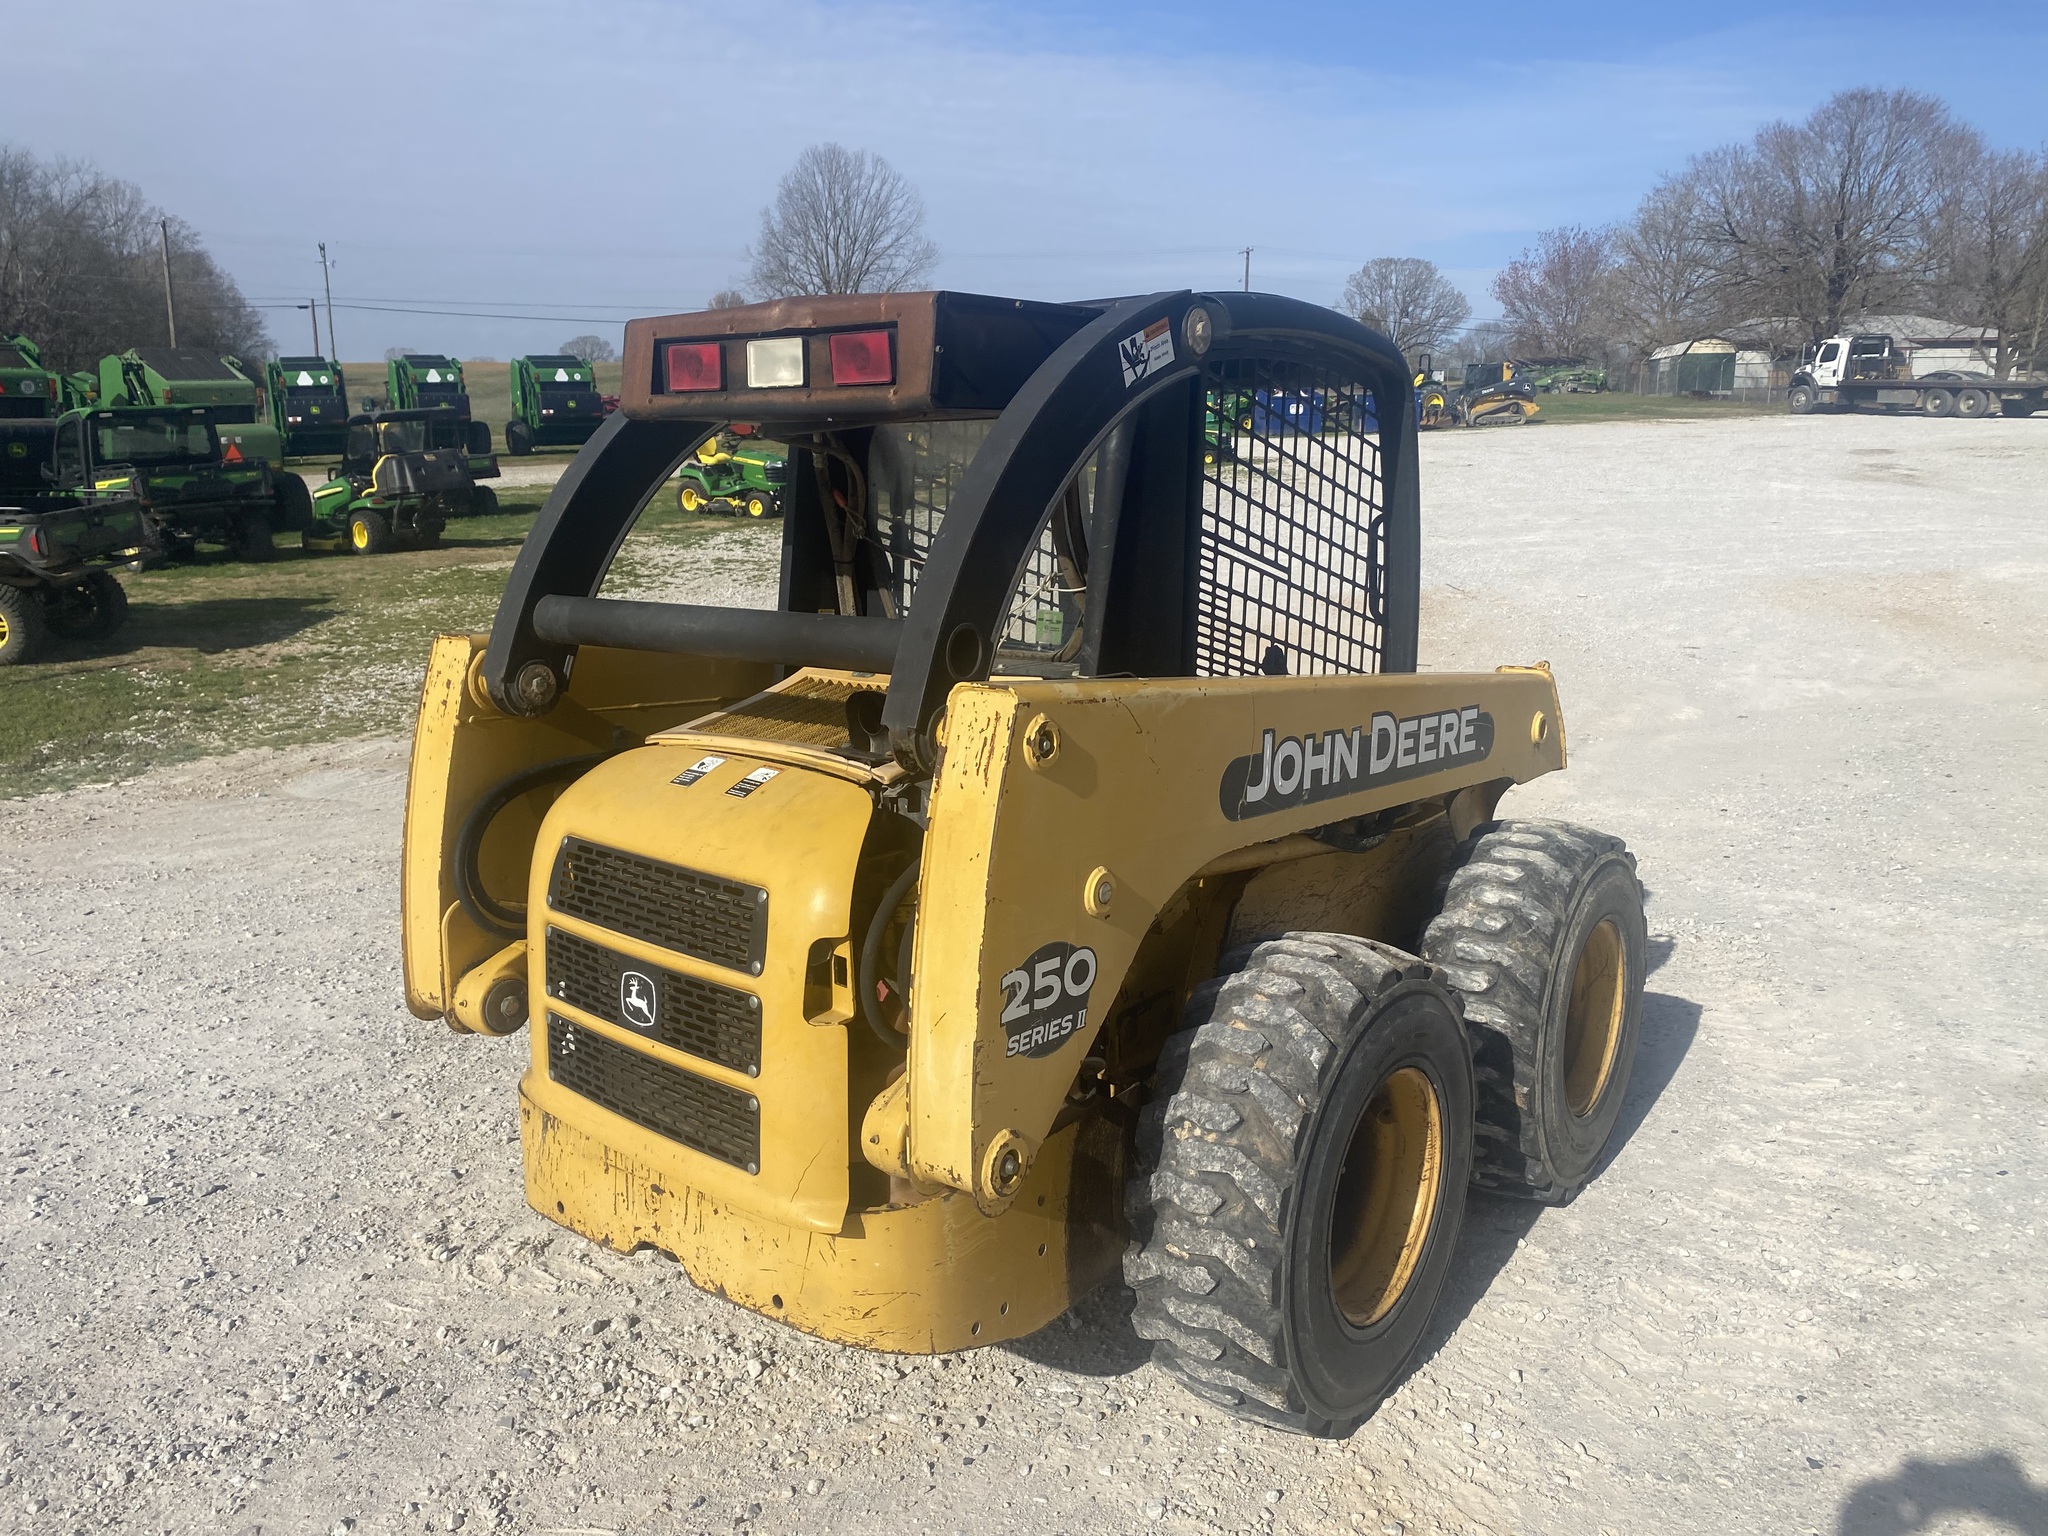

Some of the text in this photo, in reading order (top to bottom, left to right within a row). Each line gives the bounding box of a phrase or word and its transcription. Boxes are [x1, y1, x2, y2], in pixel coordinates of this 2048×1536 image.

[1246, 708, 1478, 802] JOHN DEERE
[1001, 948, 1097, 1024] 250
[1006, 1008, 1087, 1057] SERIES II
